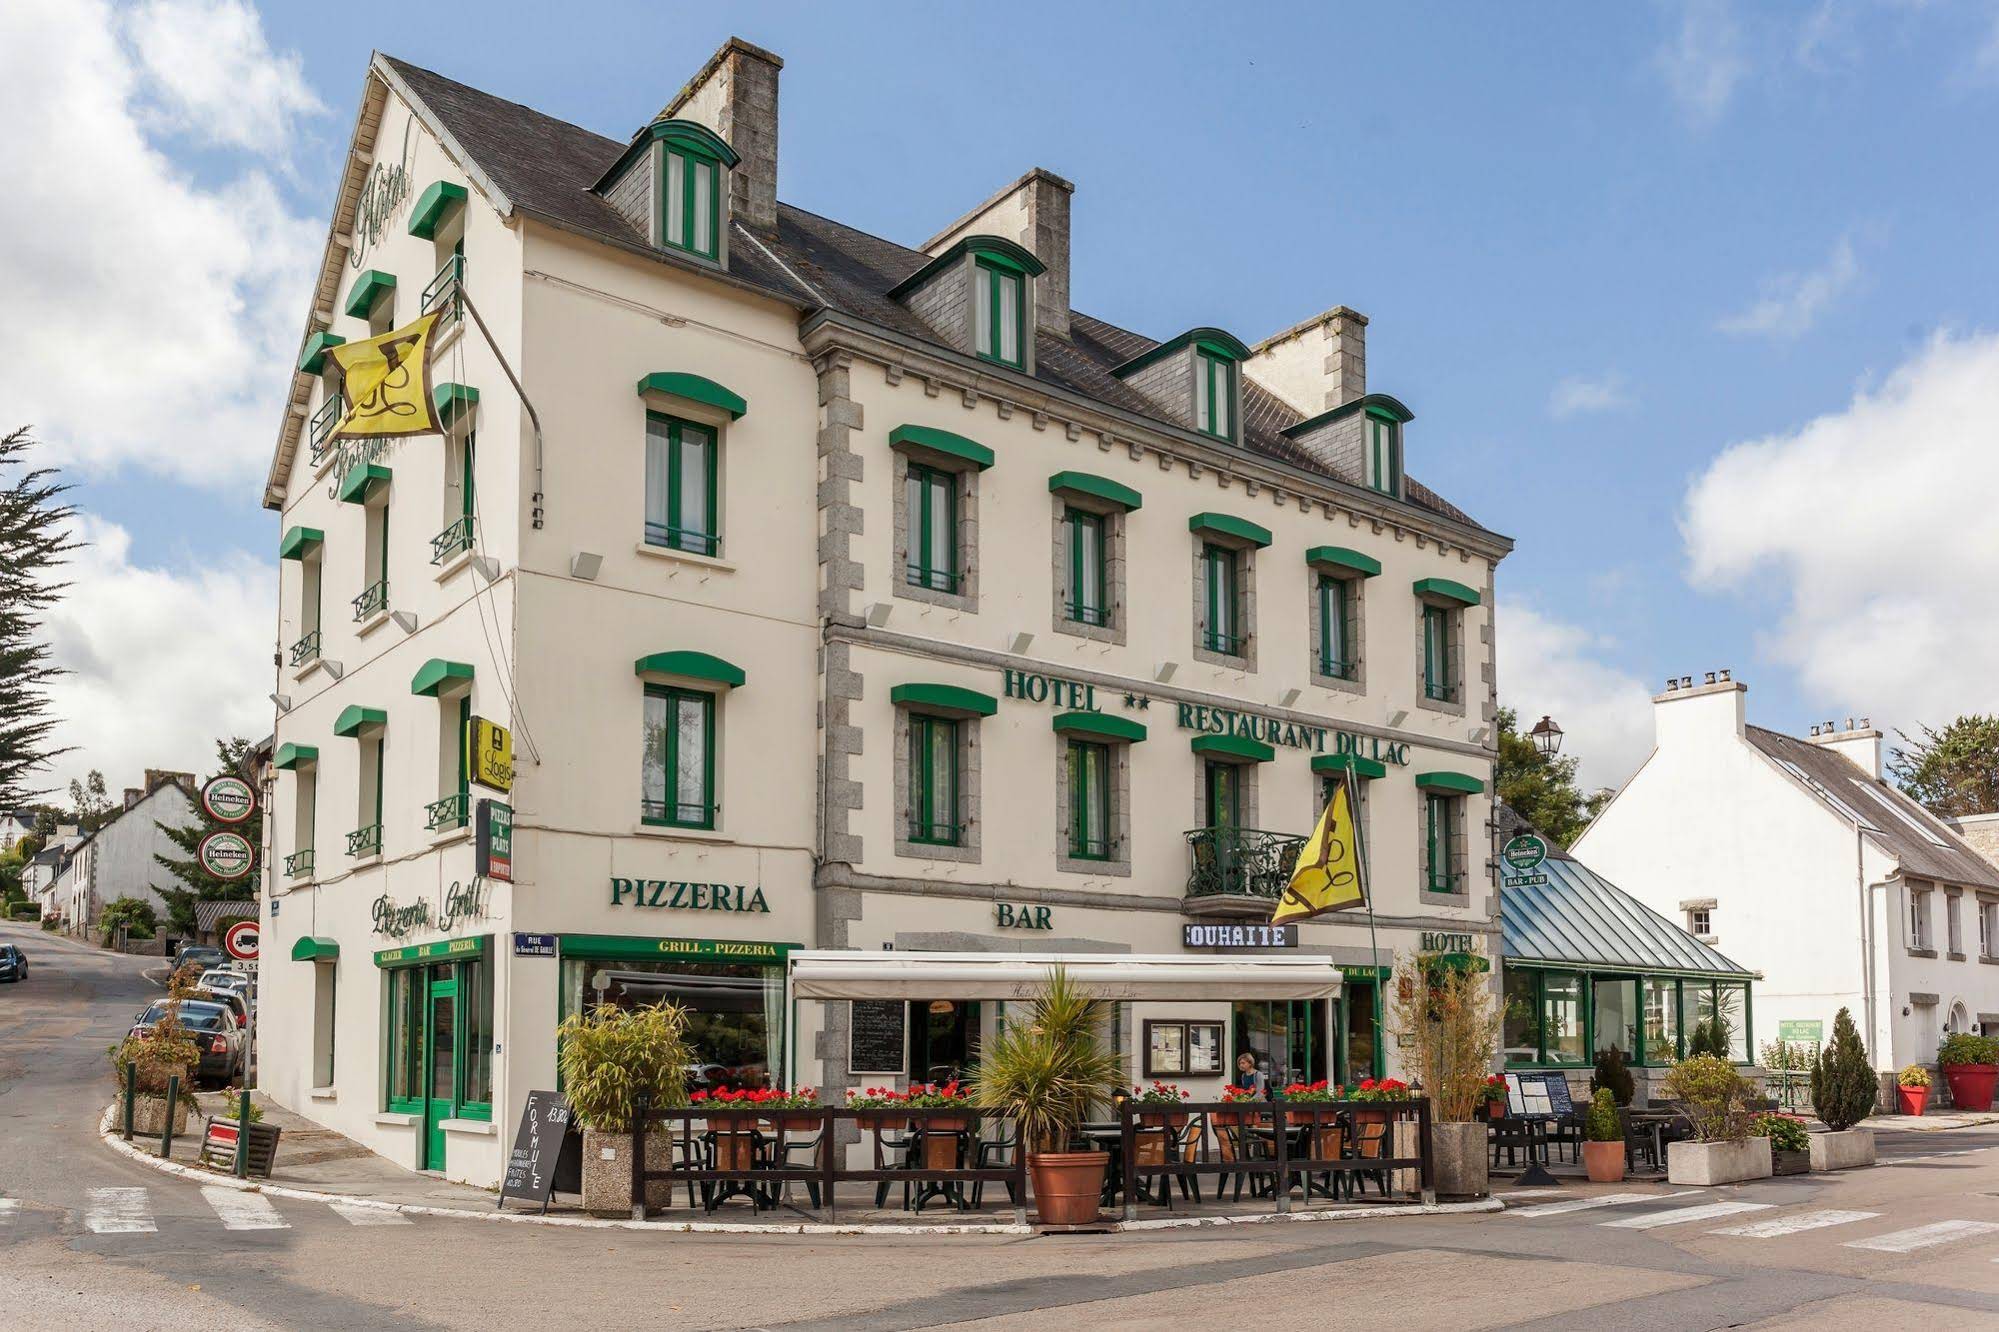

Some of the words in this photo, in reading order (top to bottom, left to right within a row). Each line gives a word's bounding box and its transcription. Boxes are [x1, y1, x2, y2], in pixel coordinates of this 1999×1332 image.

[1004, 669, 1102, 713] HOTEL
[1177, 701, 1328, 753] RESTAURANT
[1336, 731, 1364, 758] DU
[1372, 736, 1411, 767] LAC
[484, 749, 511, 785] Logis
[211, 793, 250, 805] Heineken
[490, 806, 510, 826] PIZZAS
[209, 850, 247, 859] Heineken
[1507, 878, 1523, 886] BAR
[1529, 876, 1545, 884] PUB
[610, 877, 771, 913] PIZZERIA
[997, 903, 1053, 929] BAR
[419, 945, 430, 957] BAR
[449, 939, 475, 953] PIZZERIA
[659, 941, 703, 953] GRILL
[715, 943, 776, 956] PIZZERIA
[1421, 931, 1477, 953] HOTEL
